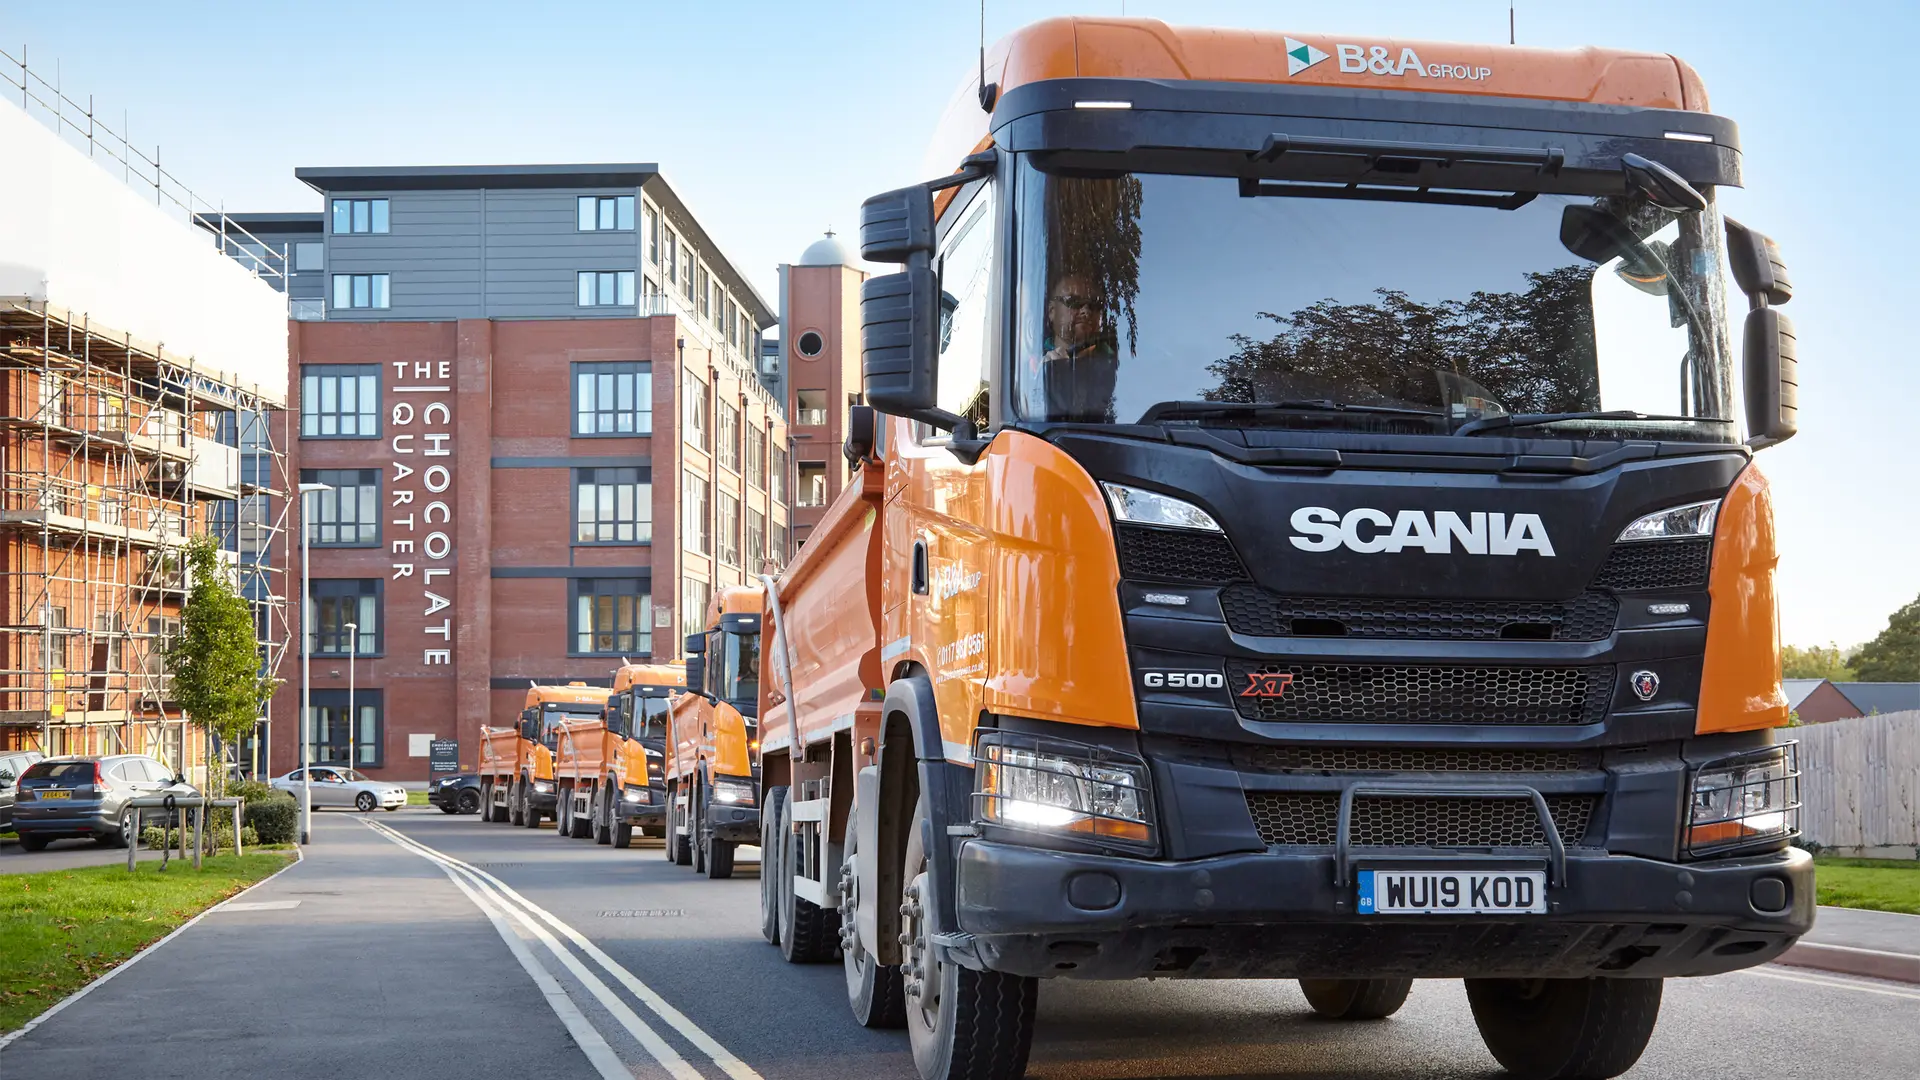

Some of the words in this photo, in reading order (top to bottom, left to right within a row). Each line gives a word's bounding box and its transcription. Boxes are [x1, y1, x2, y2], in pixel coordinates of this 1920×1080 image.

[1336, 43, 1428, 77] B&A
[1427, 64, 1492, 81] GROUP
[393, 361, 450, 379] THE
[392, 402, 414, 580] QUARTER
[424, 402, 450, 665] CHOCOLATE
[1289, 506, 1556, 557] SCANIA
[968, 631, 985, 656] 9561
[1144, 672, 1164, 688] G
[1167, 673, 1223, 688] 500
[1240, 673, 1294, 697] XT
[1360, 897, 1373, 906] GB
[1386, 876, 1460, 908] WU19
[1470, 876, 1534, 908] KOD
